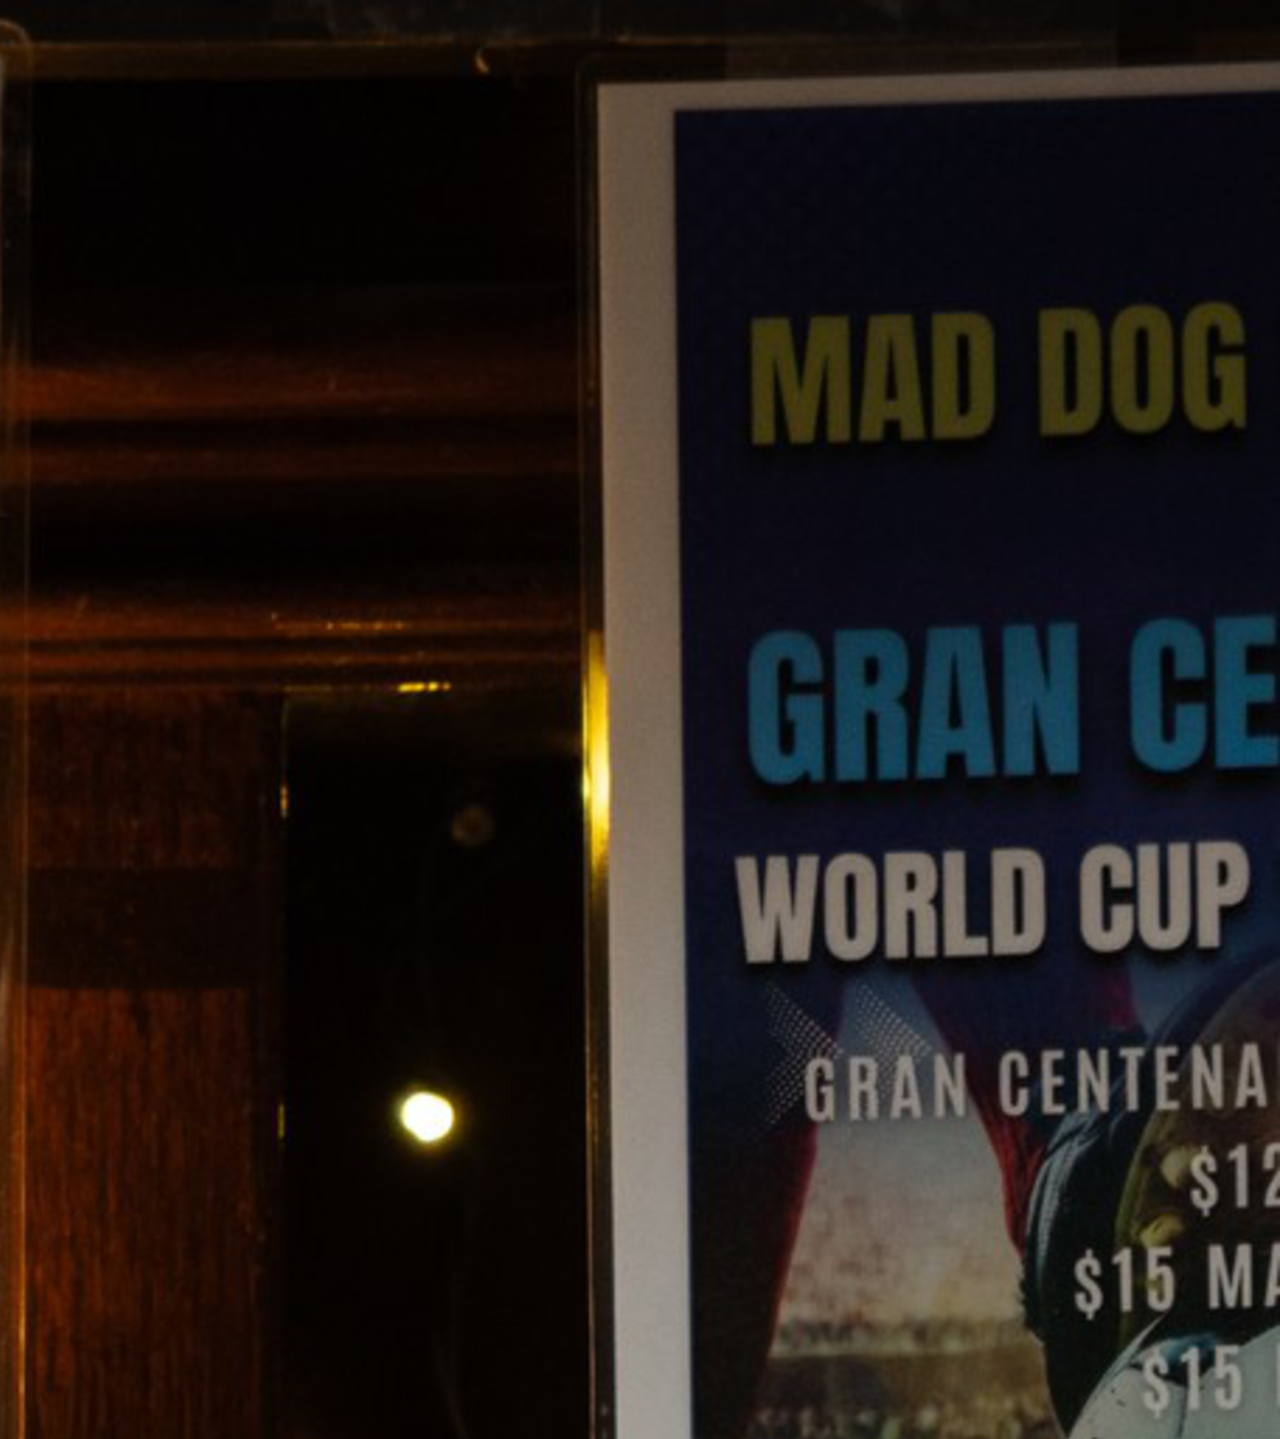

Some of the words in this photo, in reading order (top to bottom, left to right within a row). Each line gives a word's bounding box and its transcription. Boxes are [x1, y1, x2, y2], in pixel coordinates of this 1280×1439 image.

[749, 312, 997, 447] MAD
[1038, 301, 1248, 437] DOG
[746, 621, 1082, 785] GRAN
[734, 848, 1046, 967] WORLD
[1079, 840, 1251, 953] CUP
[803, 1050, 970, 1123] GRAN
[998, 1042, 1280, 1119] CENTENA
[1073, 1247, 1176, 1321] $15
[1143, 1344, 1244, 1419] $15
